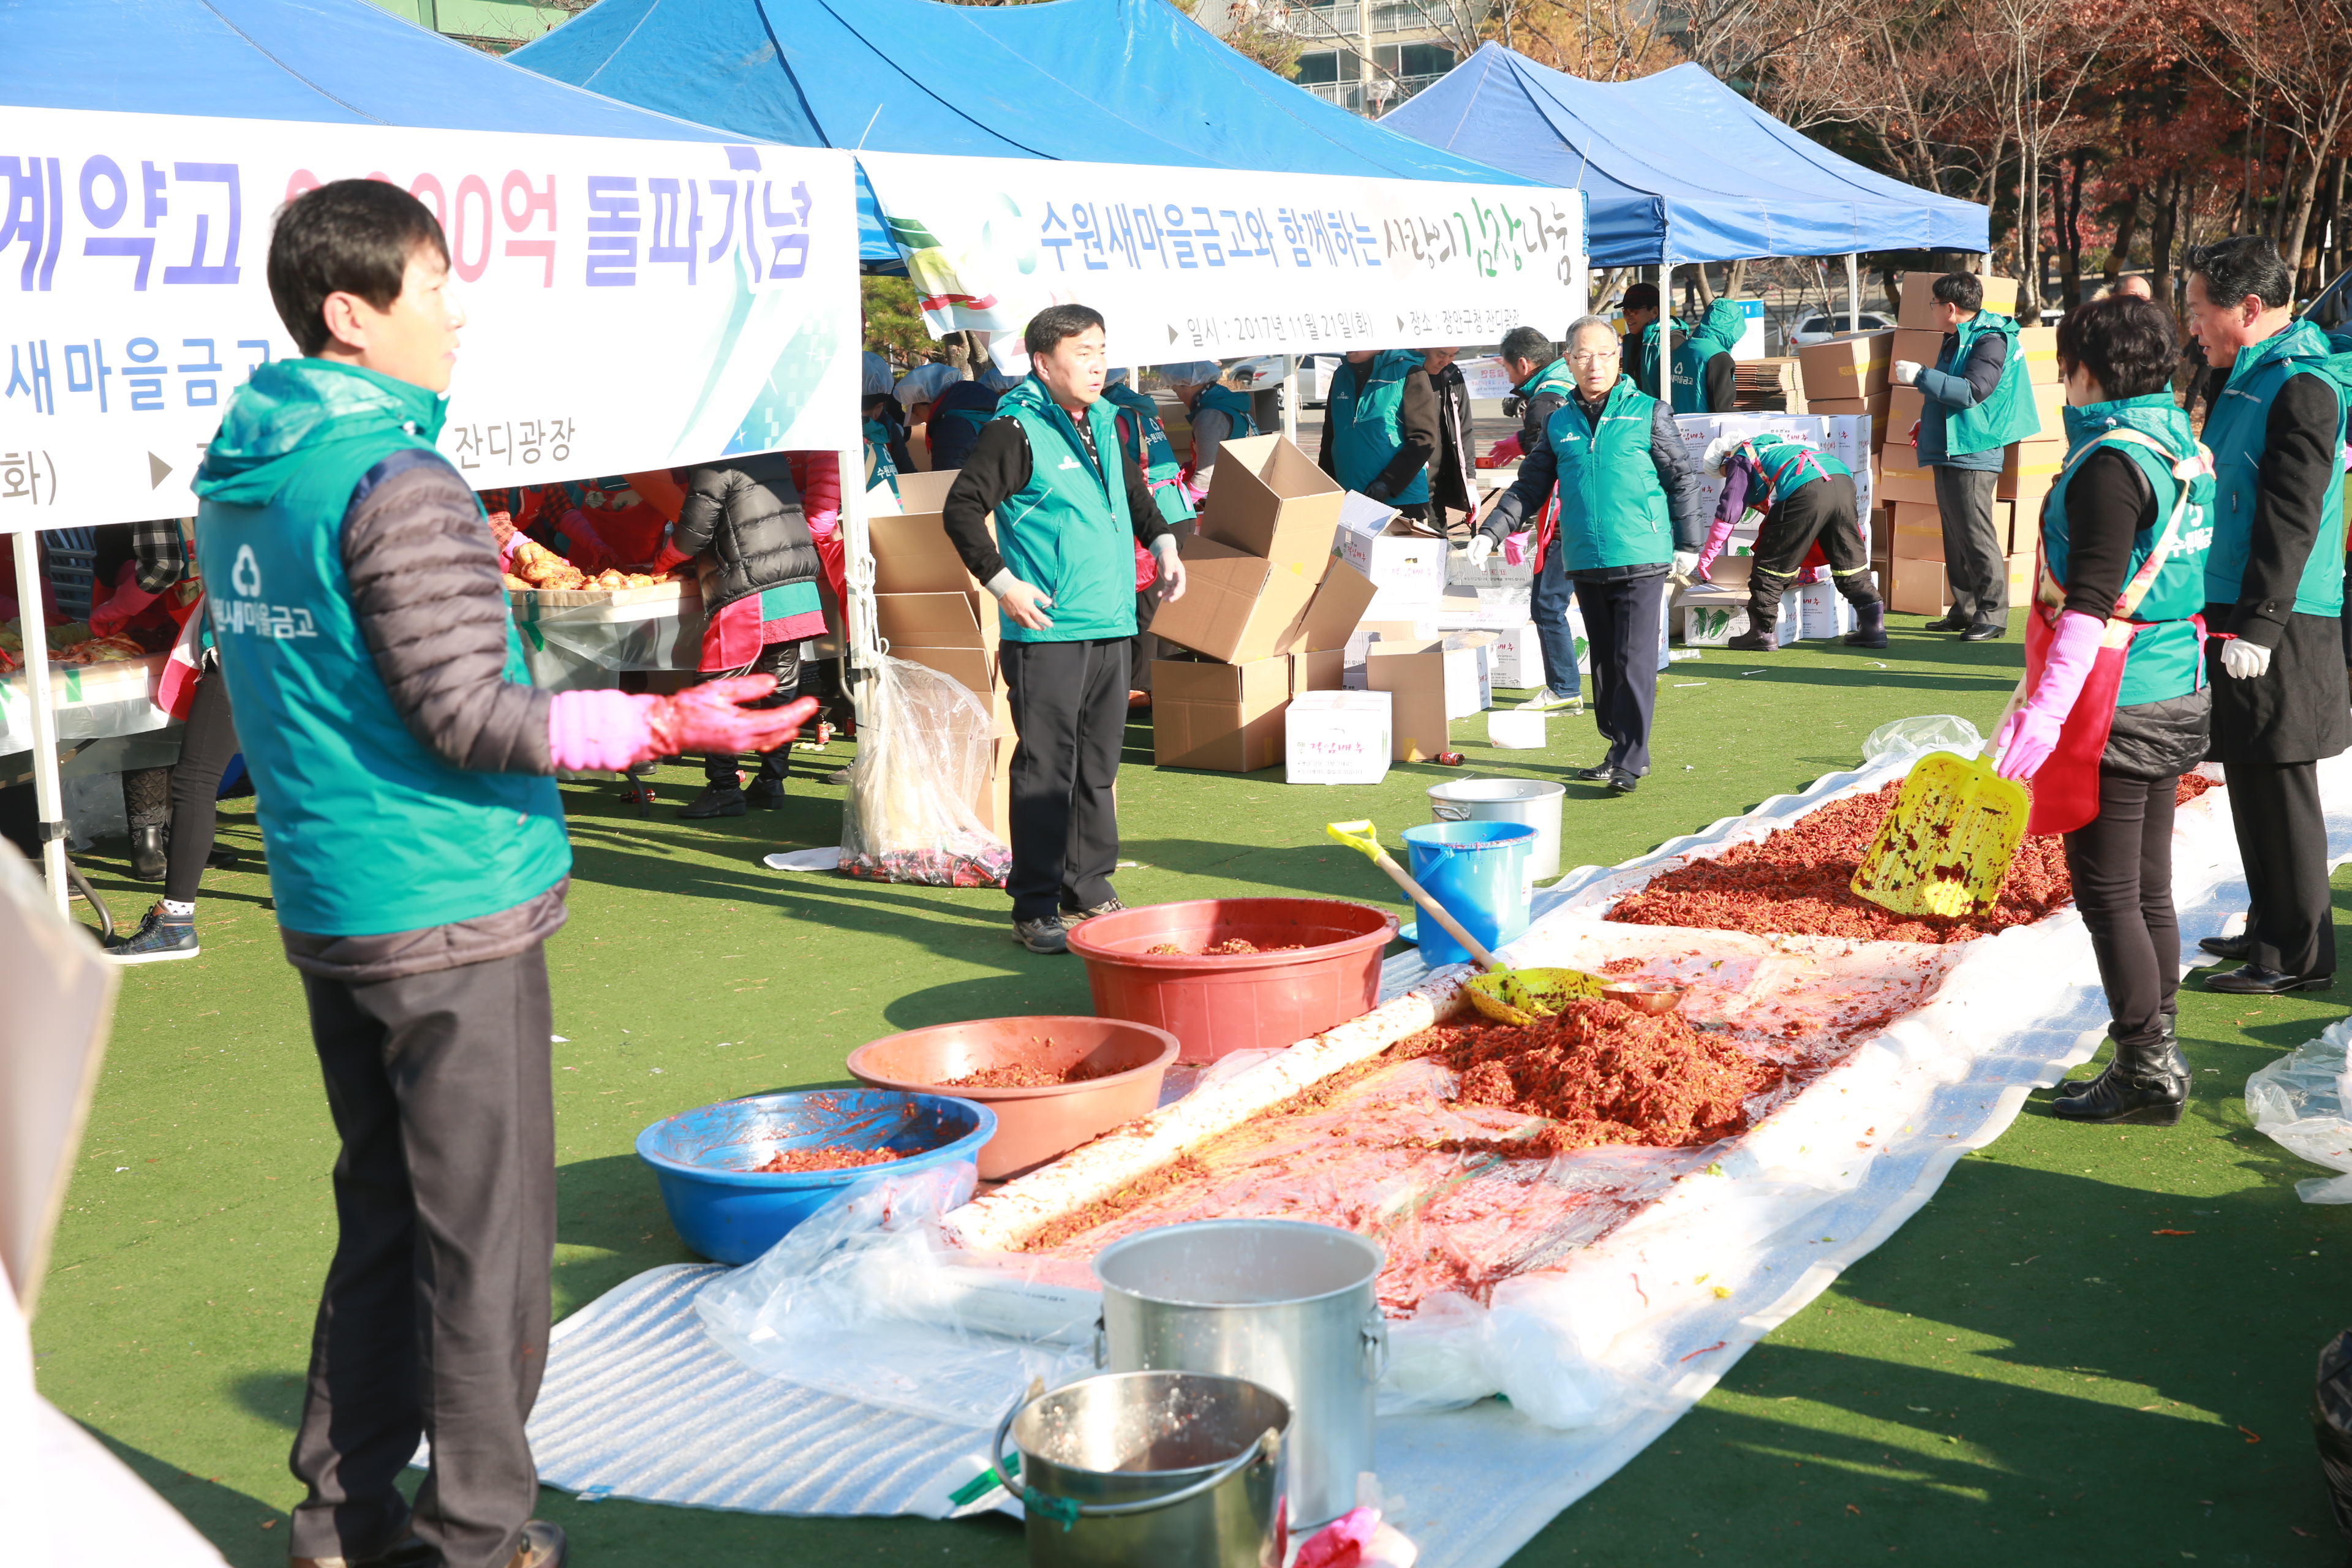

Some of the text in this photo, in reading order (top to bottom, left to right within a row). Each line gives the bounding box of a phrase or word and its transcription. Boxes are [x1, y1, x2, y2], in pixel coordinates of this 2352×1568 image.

[586, 146, 812, 287] 돌파기념
[1041, 201, 1280, 272] 수원새마을금고와
[1277, 207, 1382, 268] 함께하는
[1384, 216, 1458, 270] 사랑의
[1187, 317, 1220, 347] 일시
[1234, 314, 1286, 341] 2017년
[1289, 313, 1319, 341] 11월
[1321, 311, 1373, 339] 21일(화)
[1409, 310, 1433, 336] 장소
[1442, 309, 1483, 334] 장안구청
[1485, 308, 1520, 333] 잔디광장
[454, 417, 575, 469] 잔디광장
[1310, 742, 1366, 755] 절임배추
